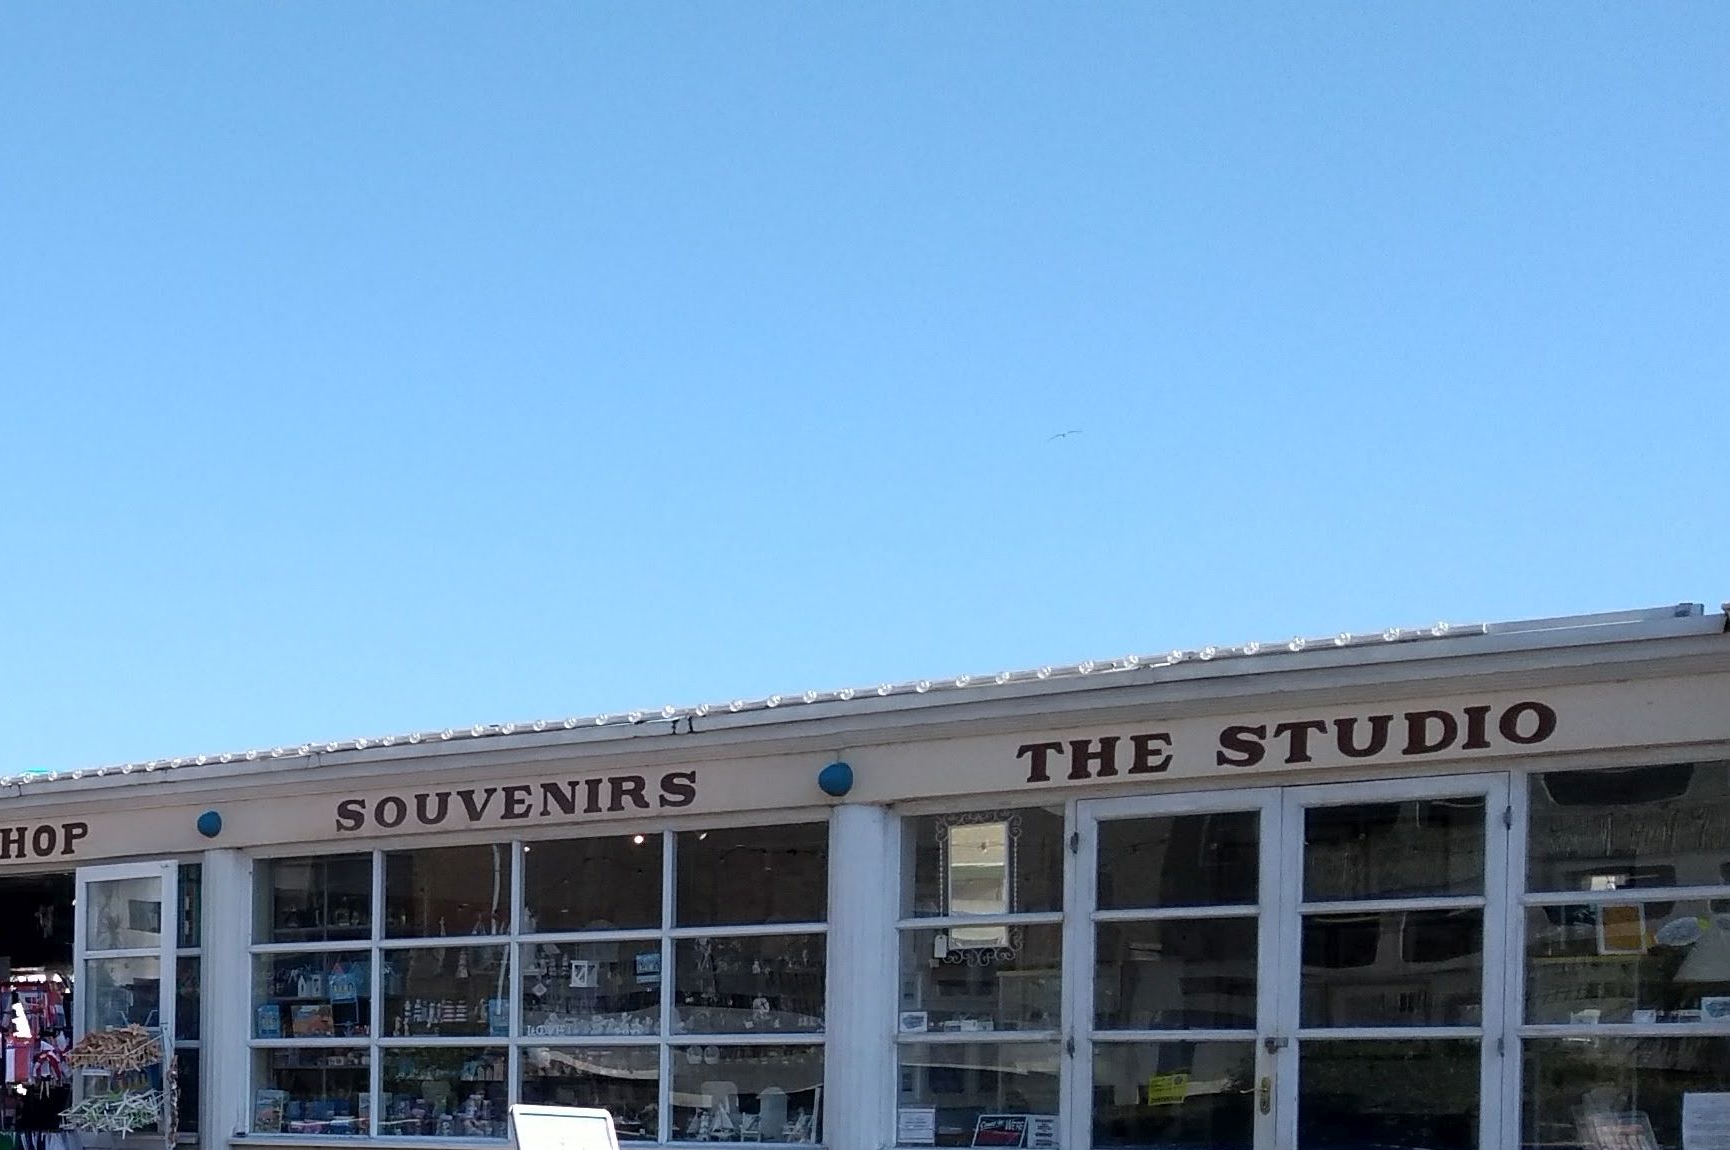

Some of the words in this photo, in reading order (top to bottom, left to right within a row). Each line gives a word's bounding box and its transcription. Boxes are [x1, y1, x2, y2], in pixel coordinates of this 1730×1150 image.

[1016, 732, 1174, 783] THE
[1216, 701, 1558, 767] STUDIO
[336, 770, 697, 832] SOUVENIRS
